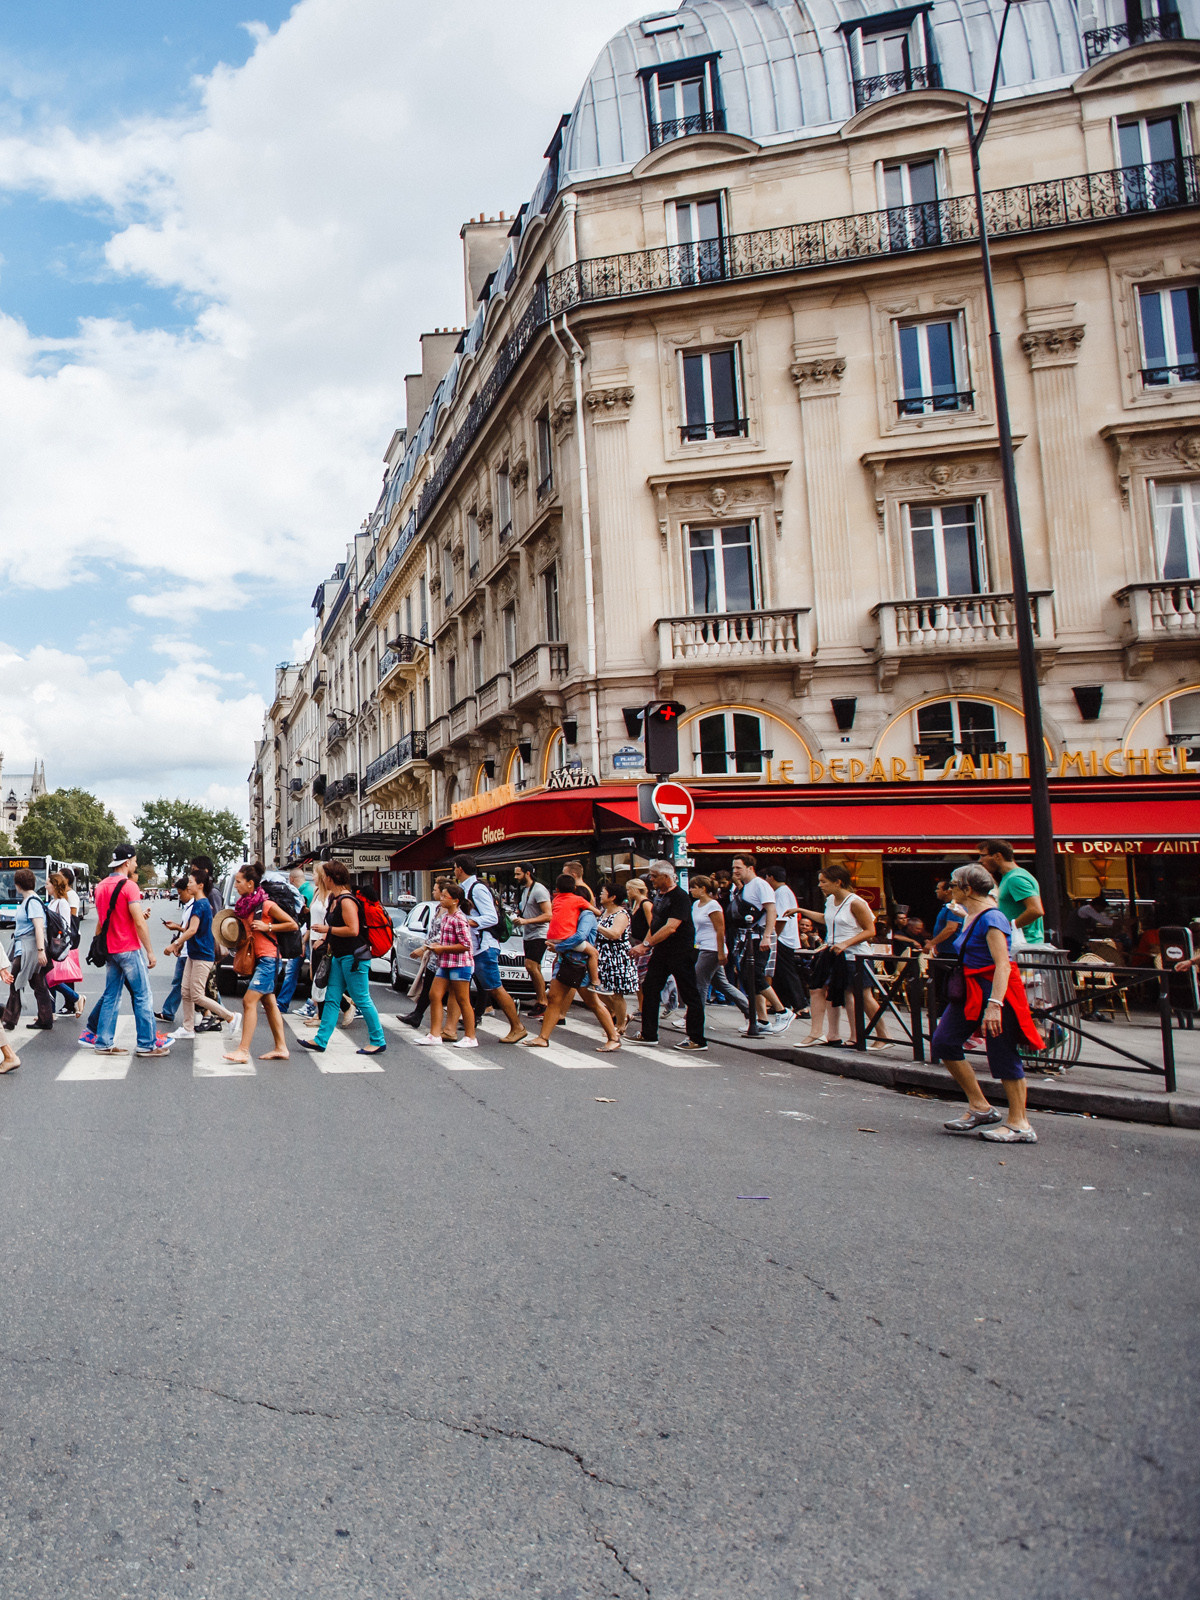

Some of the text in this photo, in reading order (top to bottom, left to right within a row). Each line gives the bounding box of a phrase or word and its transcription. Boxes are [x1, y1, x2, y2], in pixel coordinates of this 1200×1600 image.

[766, 747, 1196, 784] LE DEPART SAINT MICHEL
[545, 775, 596, 789] LAVAZZA
[375, 811, 415, 820] GIBERT
[482, 826, 505, 844] Glaces
[1057, 841, 1199, 853] LE DEPART SAINT
[9, 860, 29, 868] CASTOR
